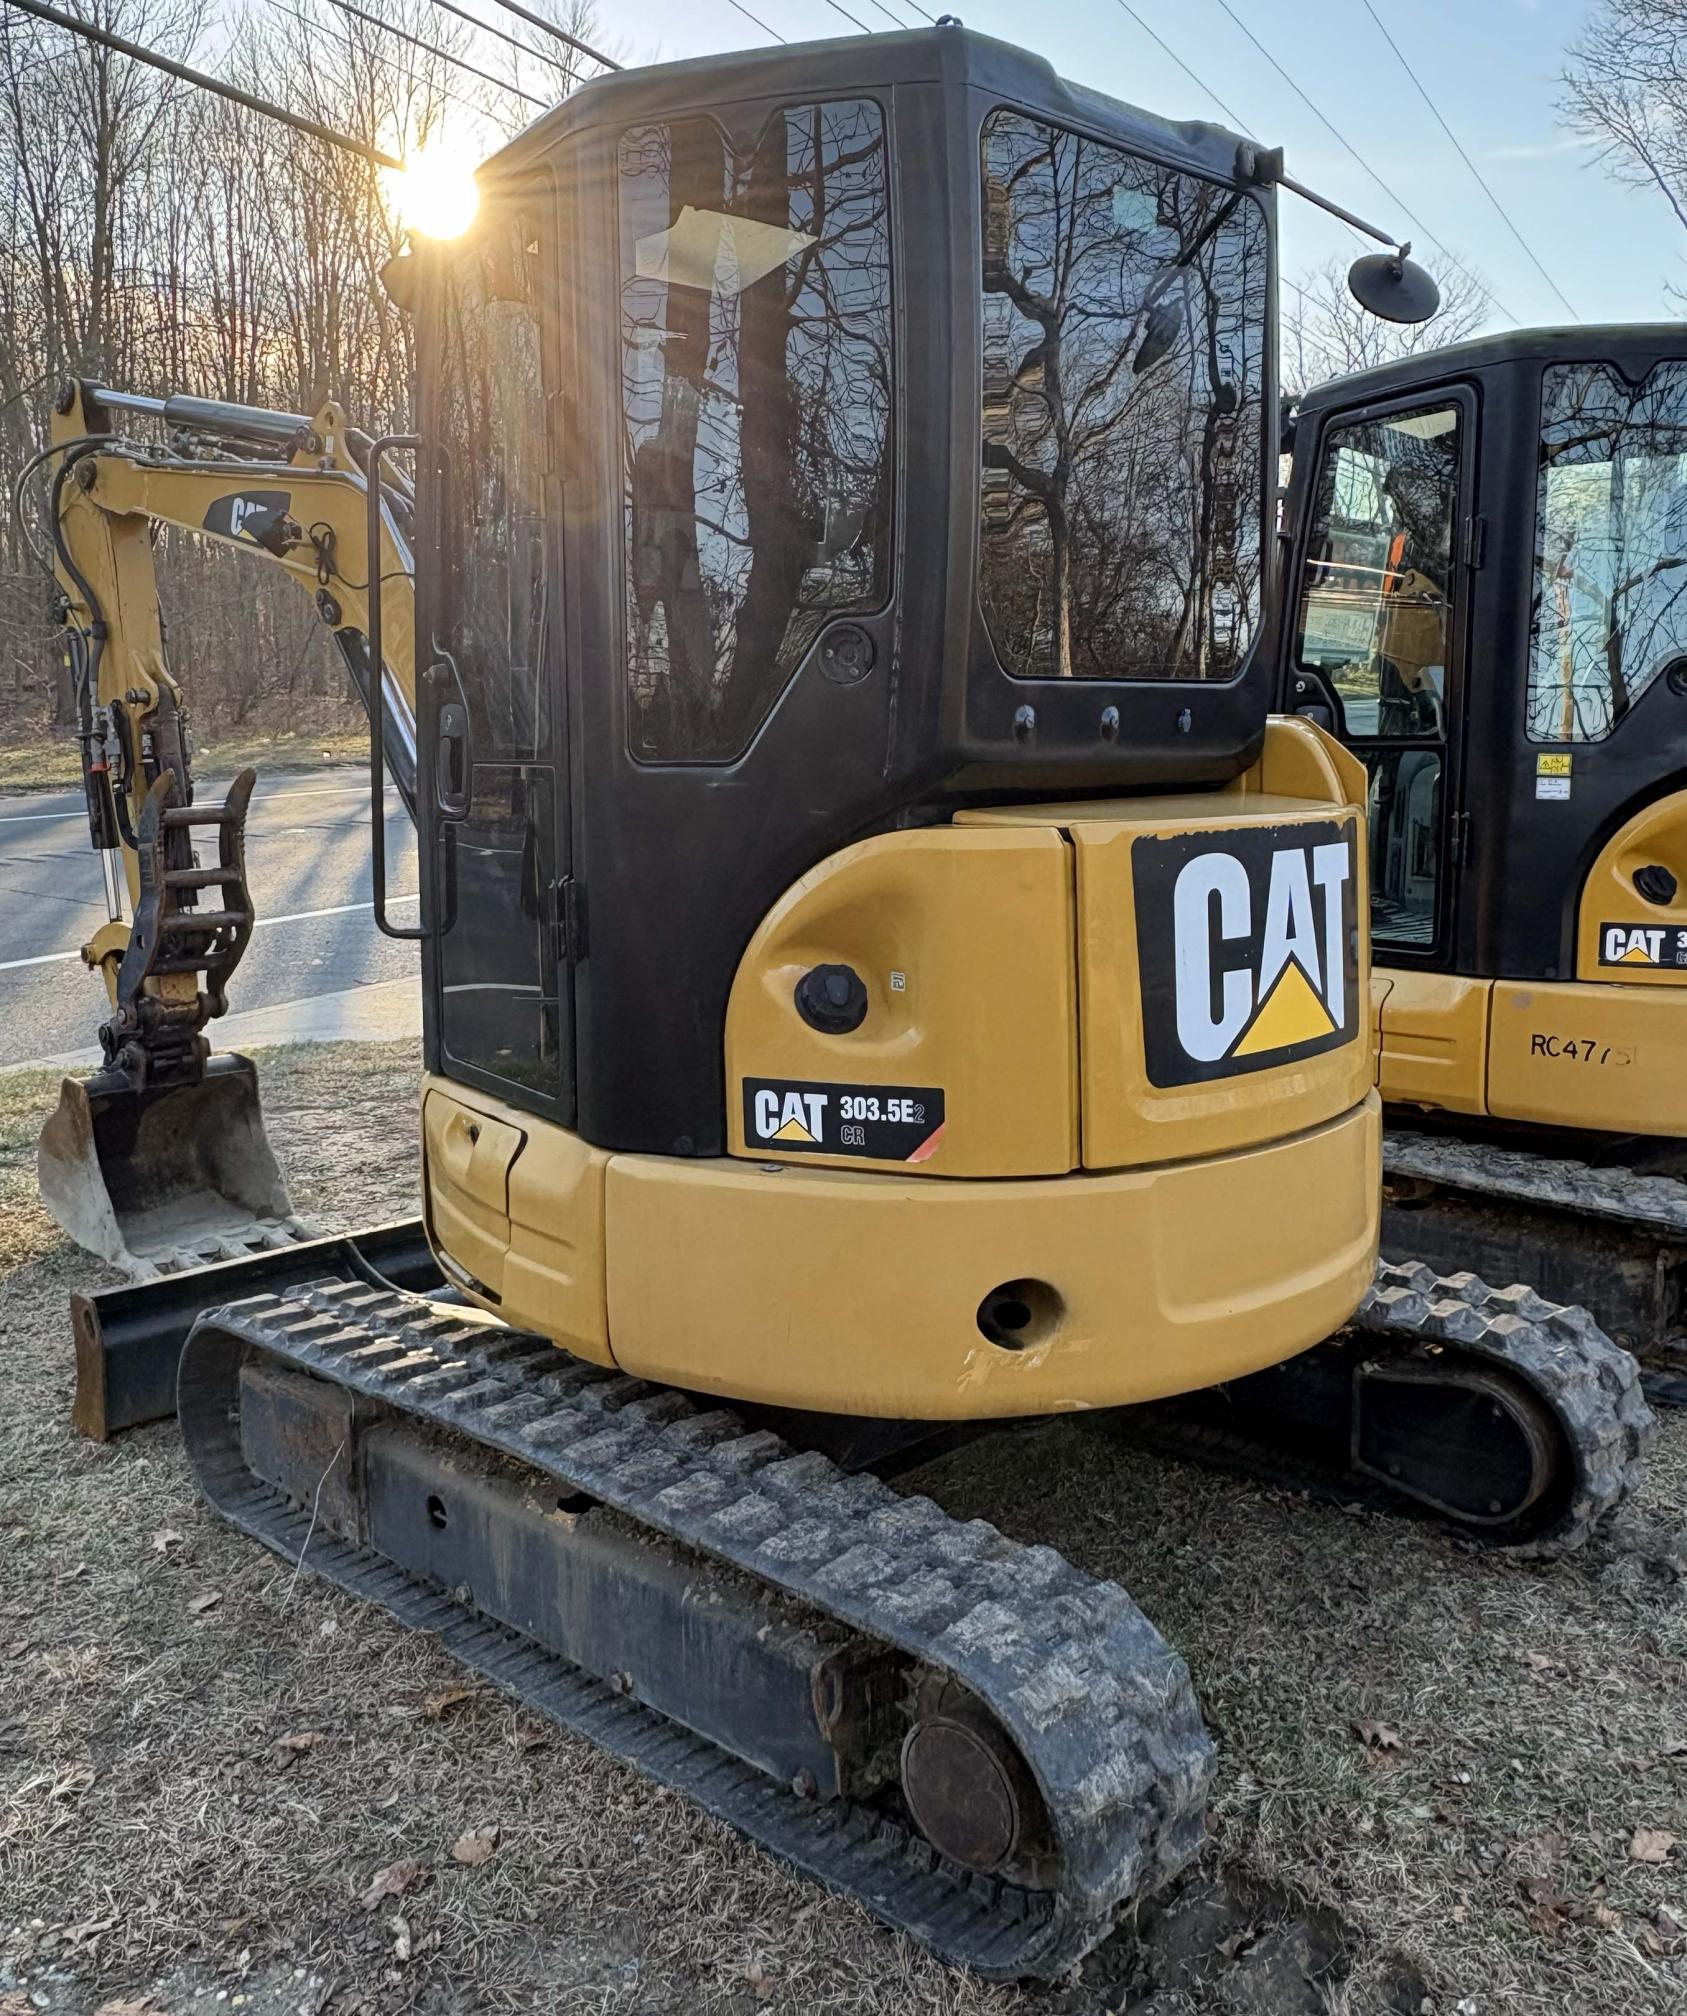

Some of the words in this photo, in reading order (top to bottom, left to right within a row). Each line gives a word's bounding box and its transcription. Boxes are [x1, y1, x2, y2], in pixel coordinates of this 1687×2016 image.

[1173, 841, 1350, 1062] CAT
[1605, 928, 1666, 963] CAT
[754, 1089, 828, 1143] CAT
[839, 1095, 925, 1124] 303.5E2
[840, 1125, 866, 1145] CR
